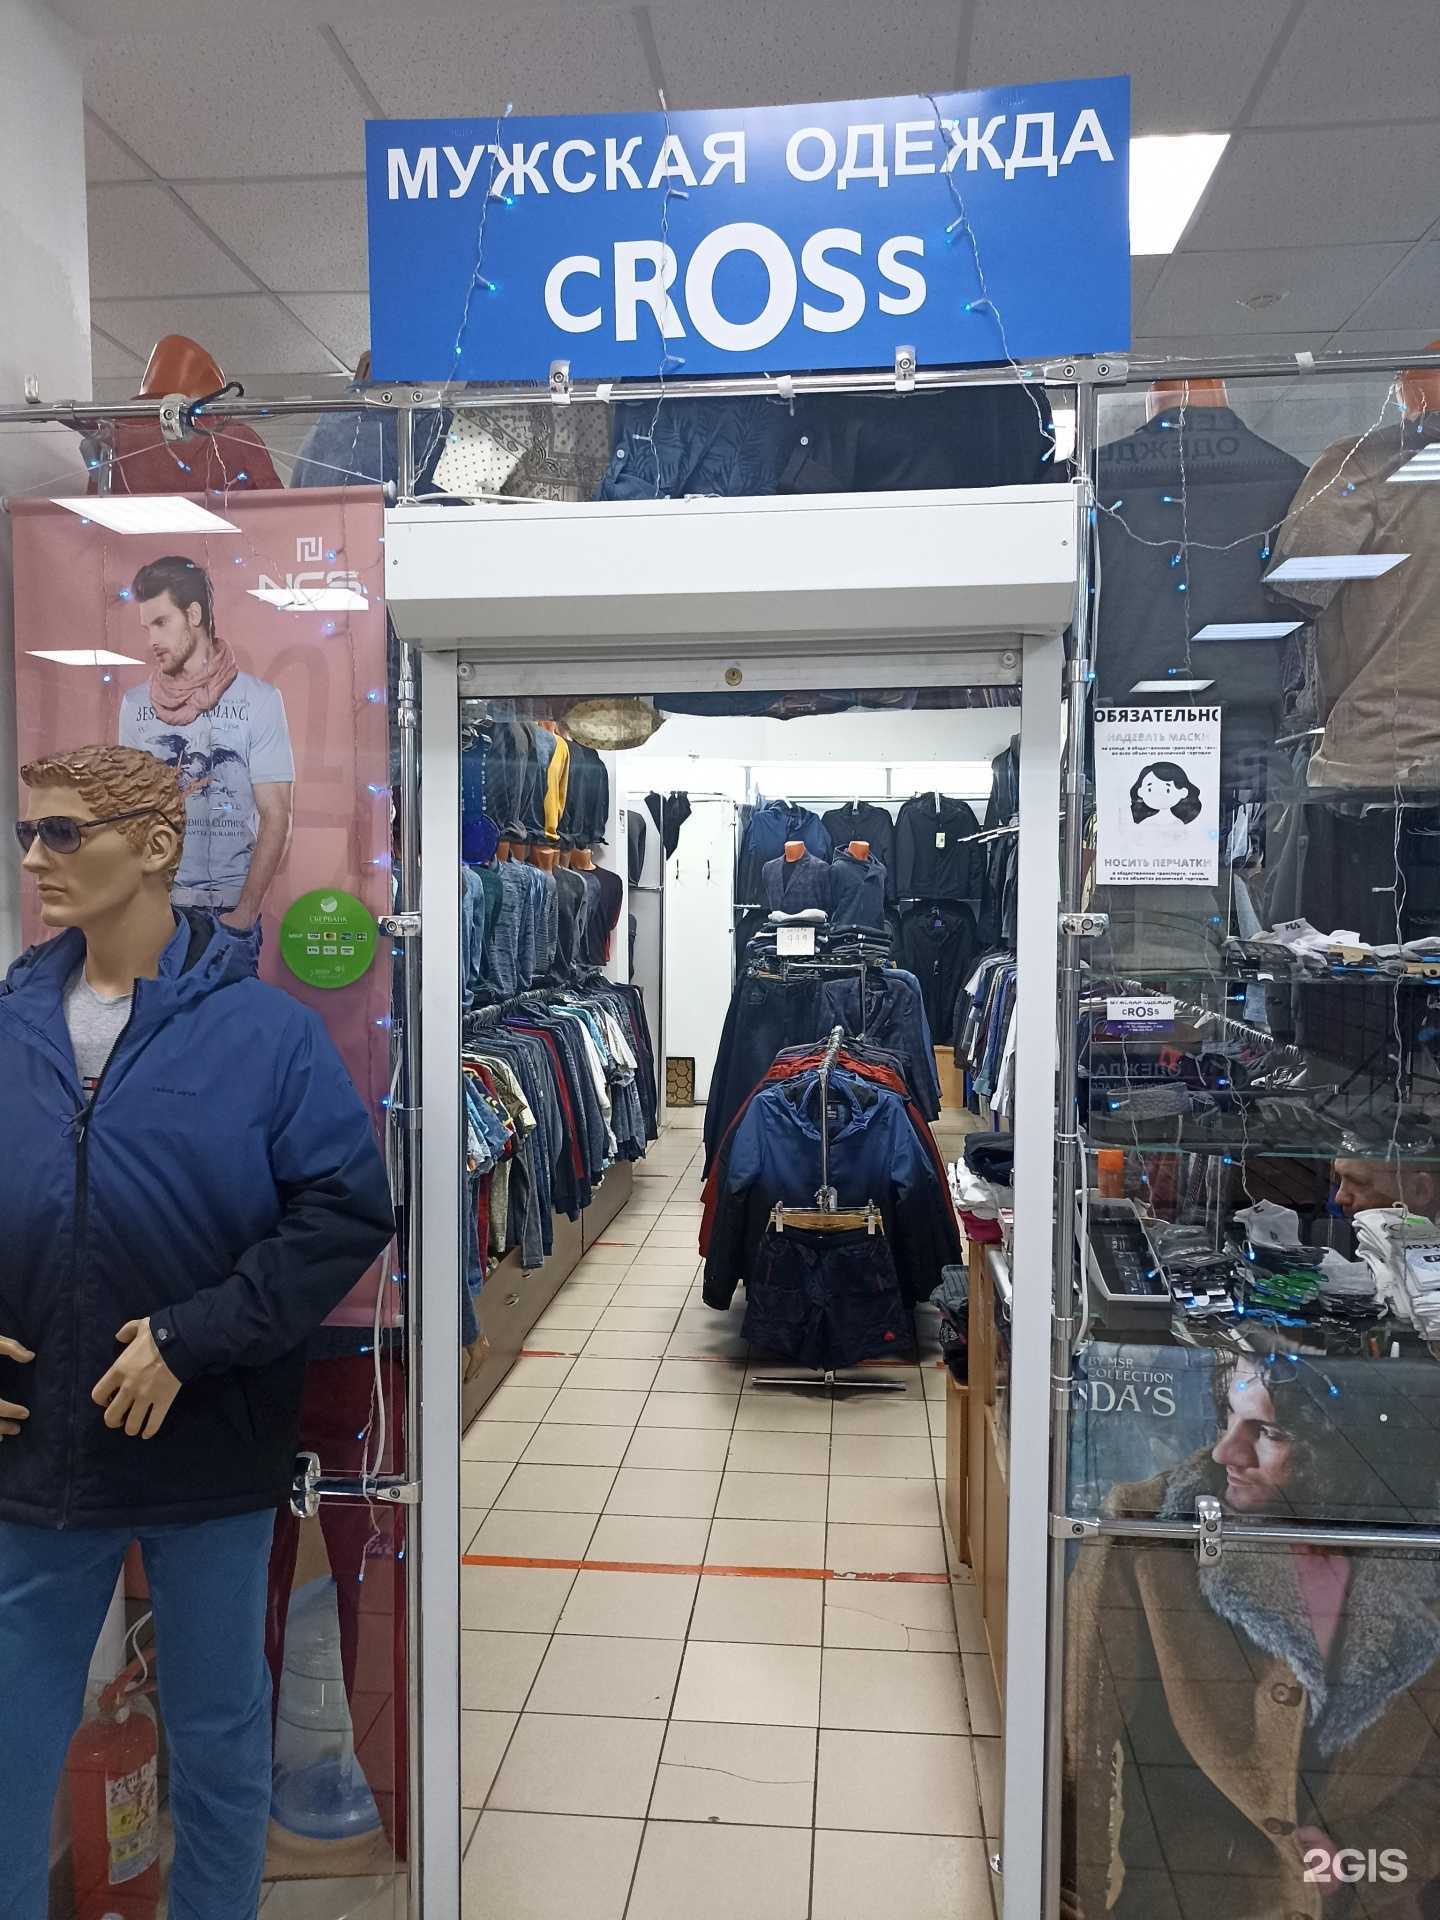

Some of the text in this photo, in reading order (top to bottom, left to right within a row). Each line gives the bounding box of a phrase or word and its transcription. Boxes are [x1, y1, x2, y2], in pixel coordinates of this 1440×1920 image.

[387, 108, 1114, 200] МУЖСКАЯ ОДЕЖДА
[1104, 858, 1149, 868] НОСИТЬ
[1088, 1367, 1174, 1384] COLLECTION
